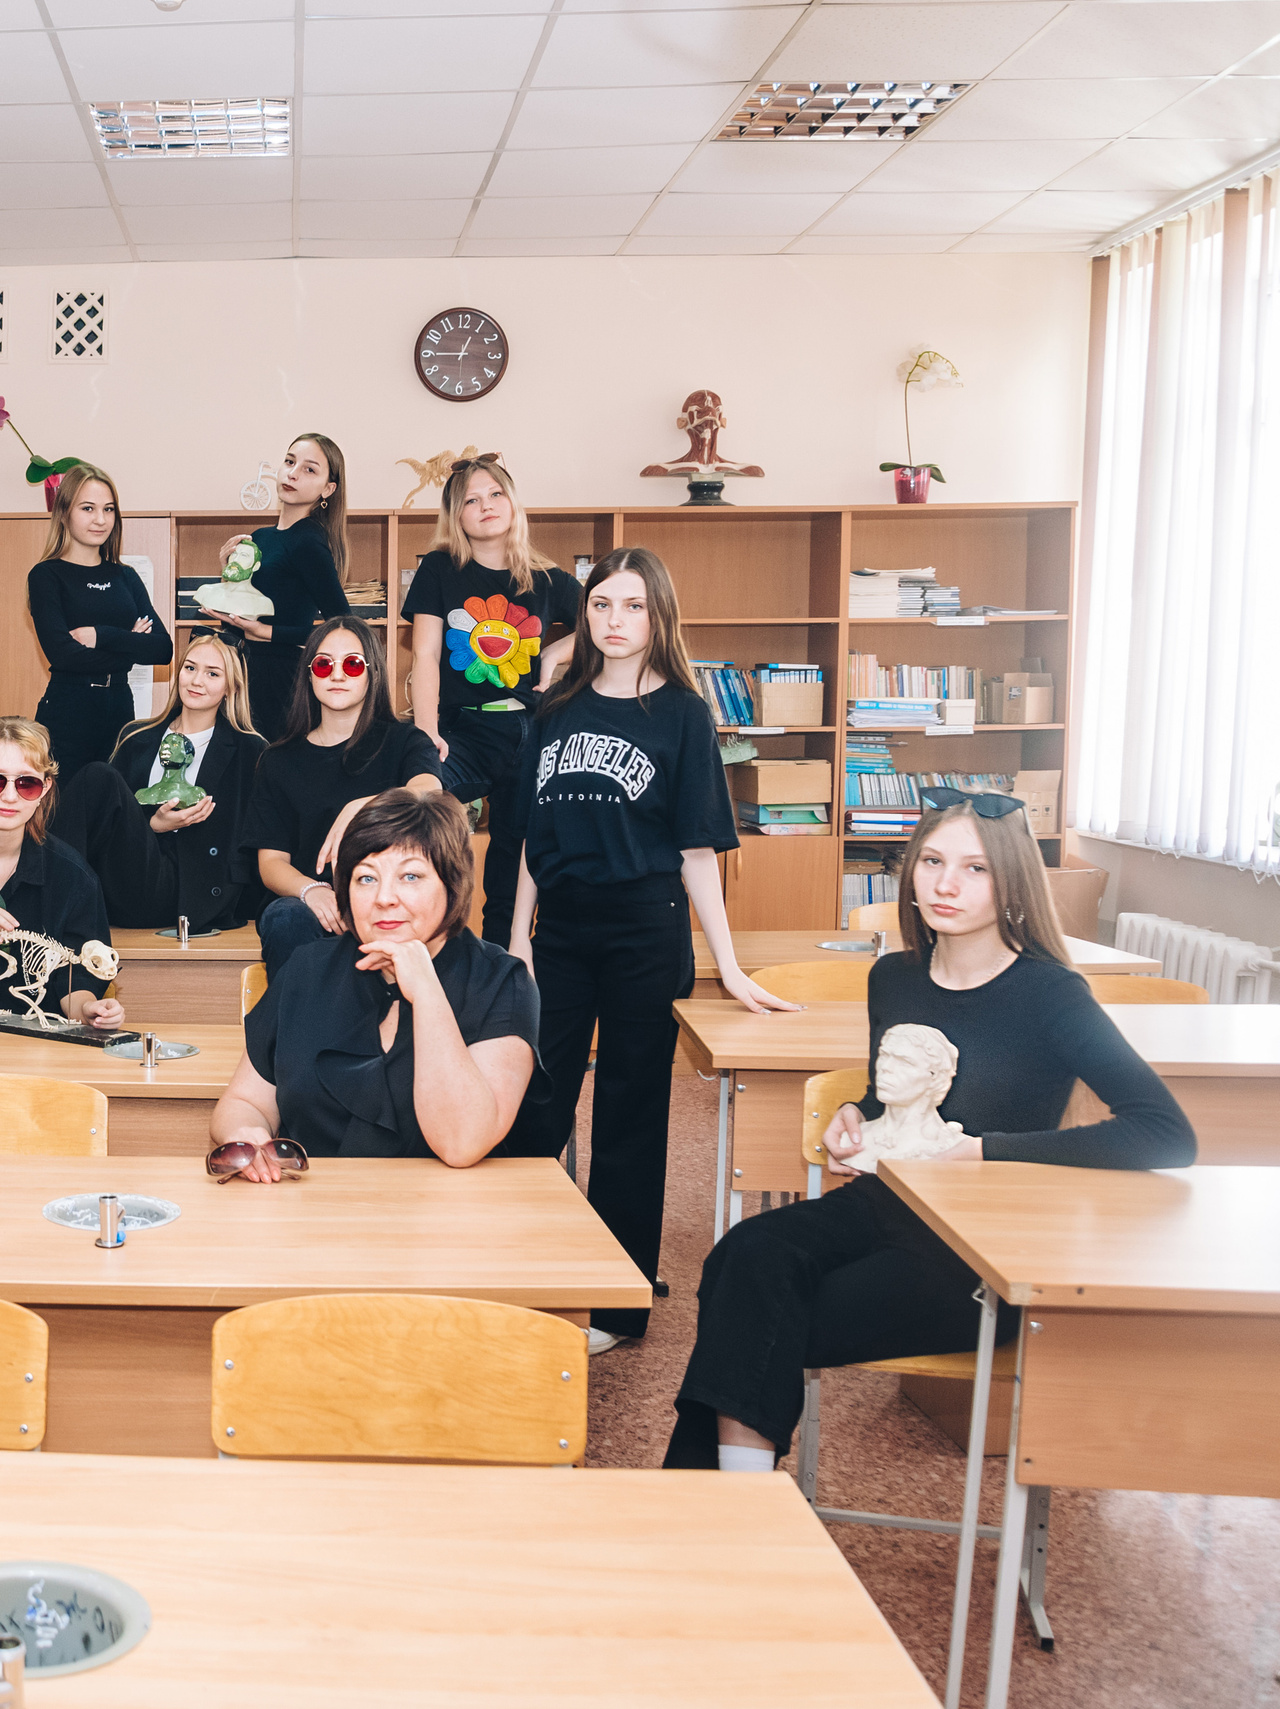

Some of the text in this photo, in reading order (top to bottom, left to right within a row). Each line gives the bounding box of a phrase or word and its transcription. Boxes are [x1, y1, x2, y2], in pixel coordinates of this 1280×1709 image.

[440, 317, 454, 333] 11
[458, 314, 471, 329] 12
[475, 320, 485, 333] 1
[426, 329, 441, 345] 10
[483, 333, 498, 344] 2
[421, 350, 435, 358] 9
[487, 352, 502, 360] 3
[425, 365, 438, 375] 8
[483, 367, 496, 378] 4
[440, 375, 449, 389] 7
[455, 381, 462, 395] 6
[471, 376, 481, 391] 5
[536, 732, 656, 801] OS ANGELES
